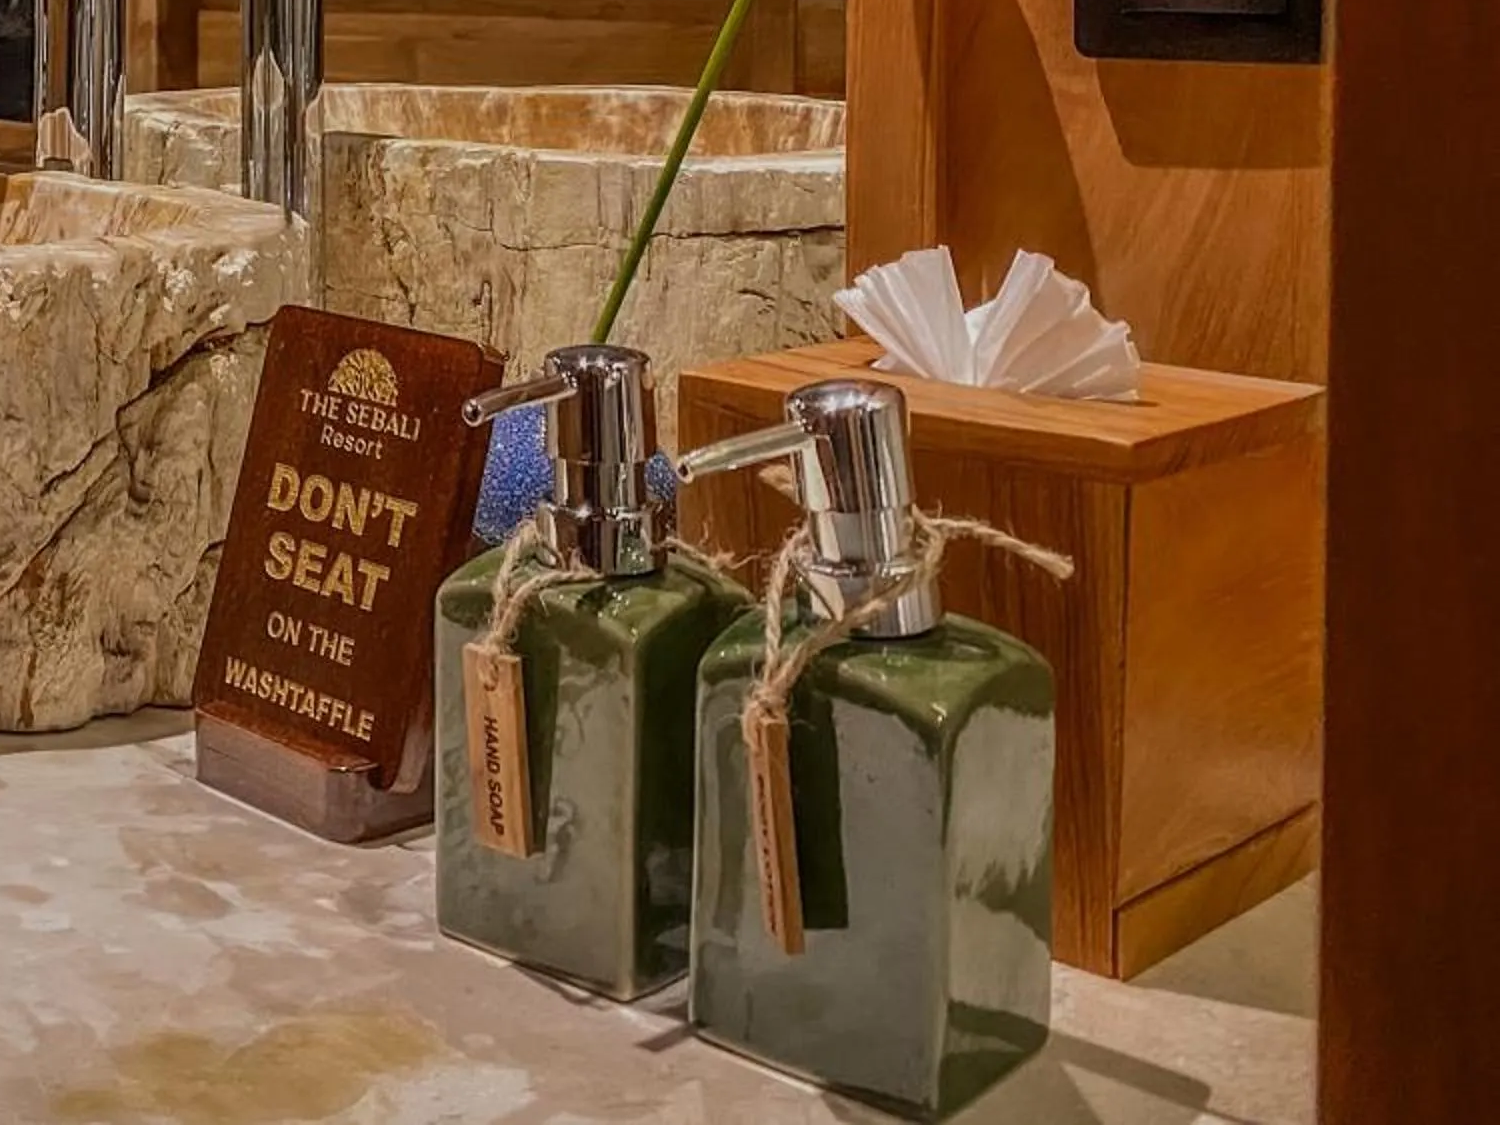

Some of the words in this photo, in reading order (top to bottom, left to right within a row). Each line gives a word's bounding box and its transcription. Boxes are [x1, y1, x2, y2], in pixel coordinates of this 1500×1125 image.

[300, 388, 342, 420] THE
[345, 401, 420, 442] SEBALI
[320, 423, 383, 460] Resort
[267, 462, 419, 548] DON'T
[264, 531, 391, 612] SEAT
[267, 610, 302, 646] ON
[308, 622, 355, 666] THE
[224, 656, 375, 742] WASHTAFFLE
[482, 714, 502, 774] HAND
[487, 779, 505, 836] SOAP
